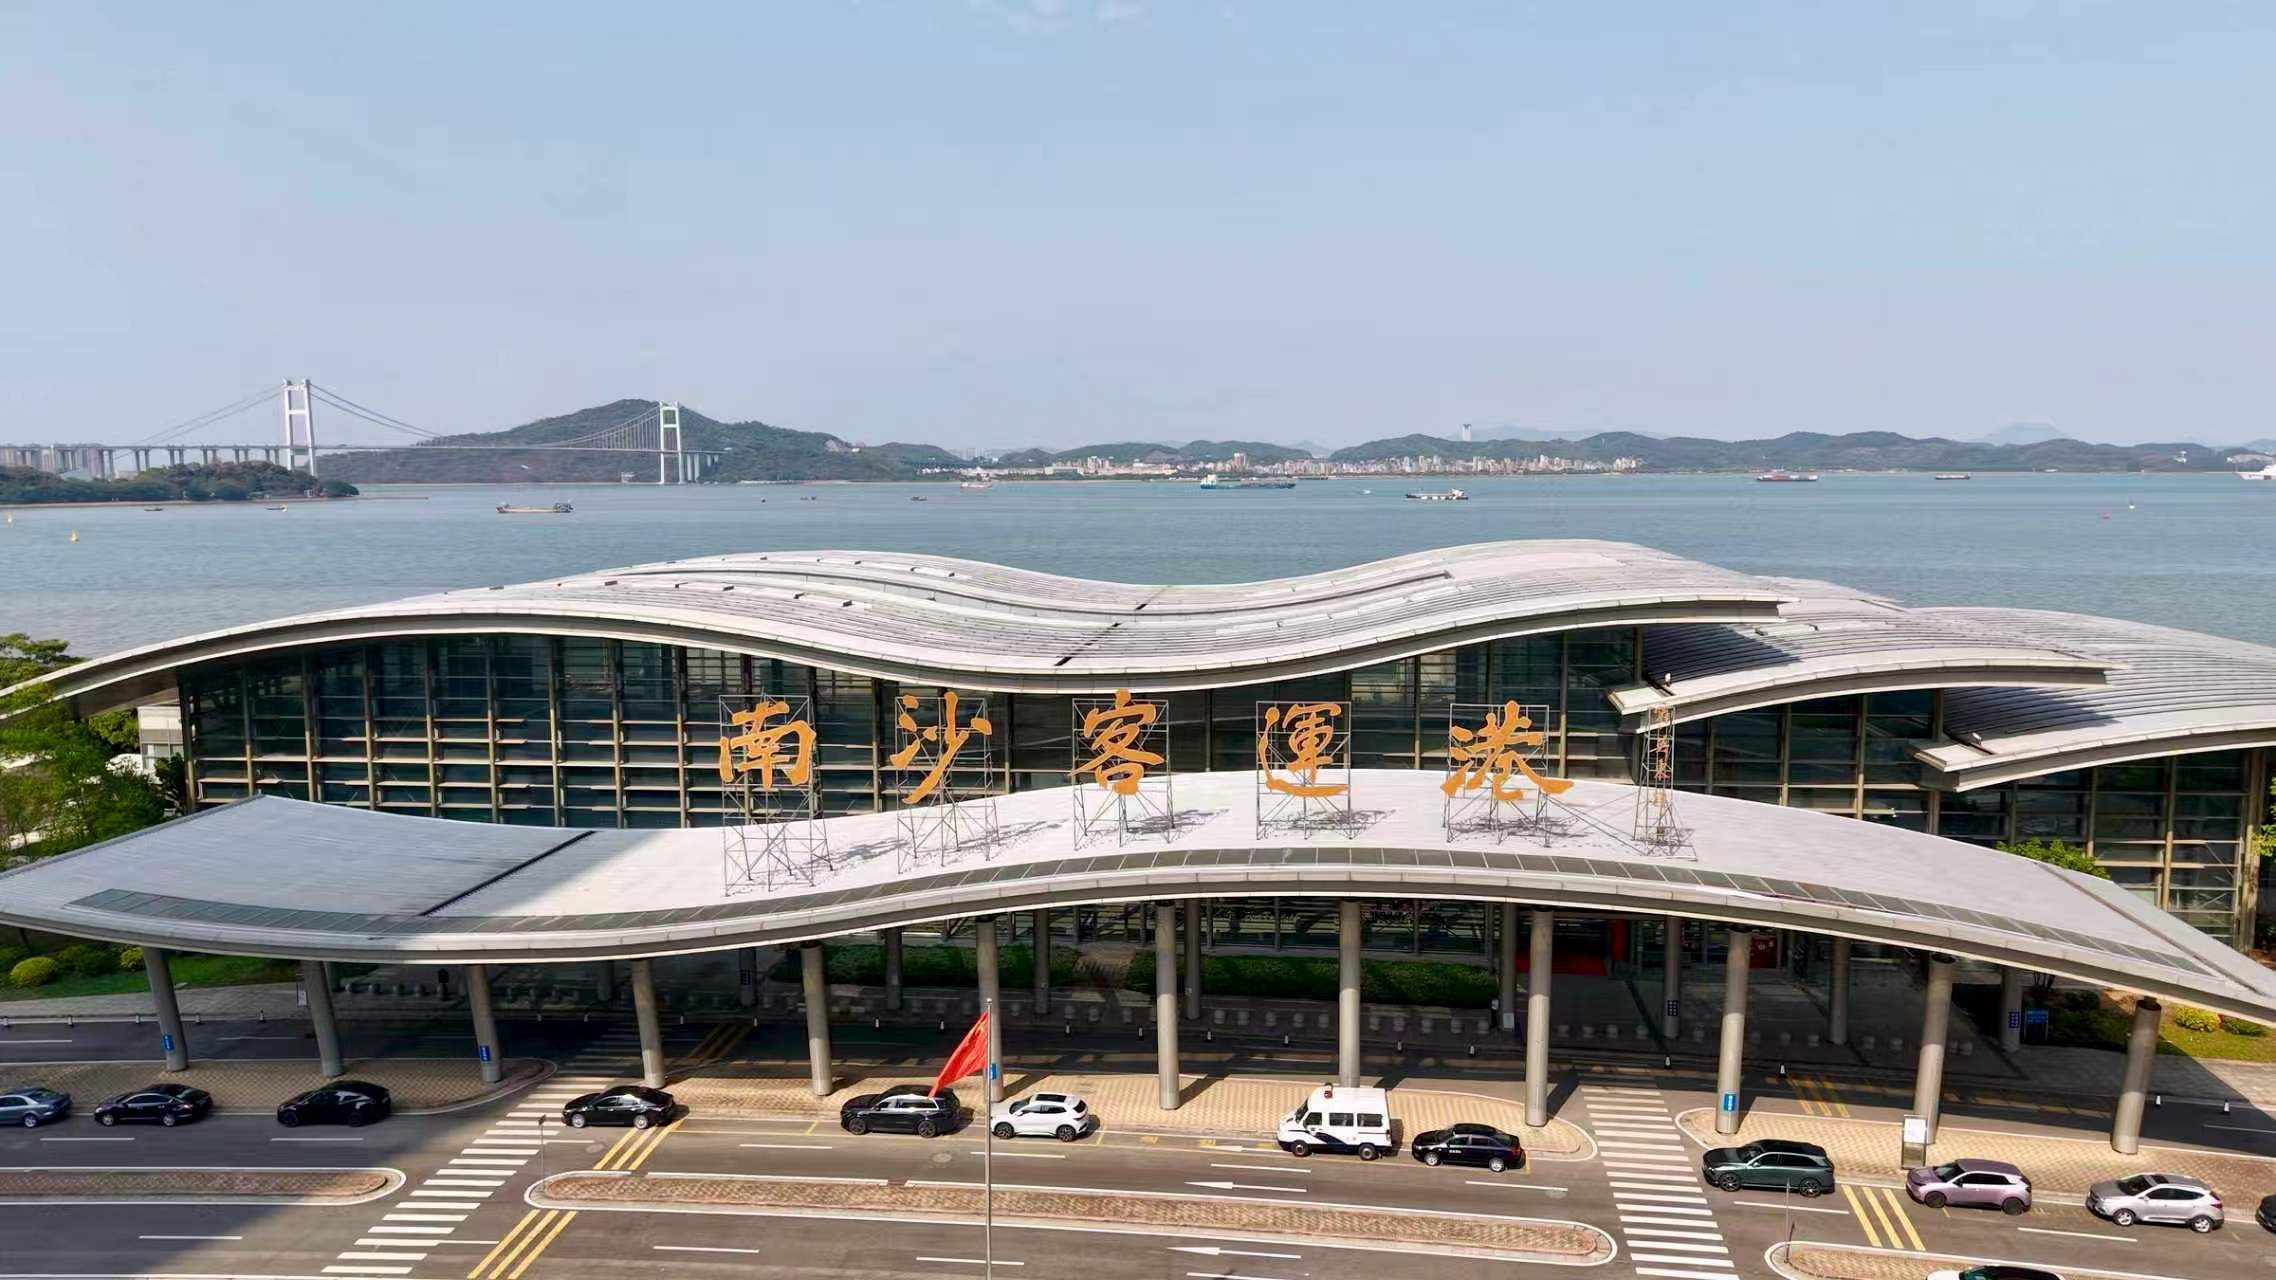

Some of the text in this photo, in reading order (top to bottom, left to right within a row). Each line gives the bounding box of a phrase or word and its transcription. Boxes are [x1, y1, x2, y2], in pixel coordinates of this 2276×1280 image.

[719, 689, 1572, 803] 南沙客運港
